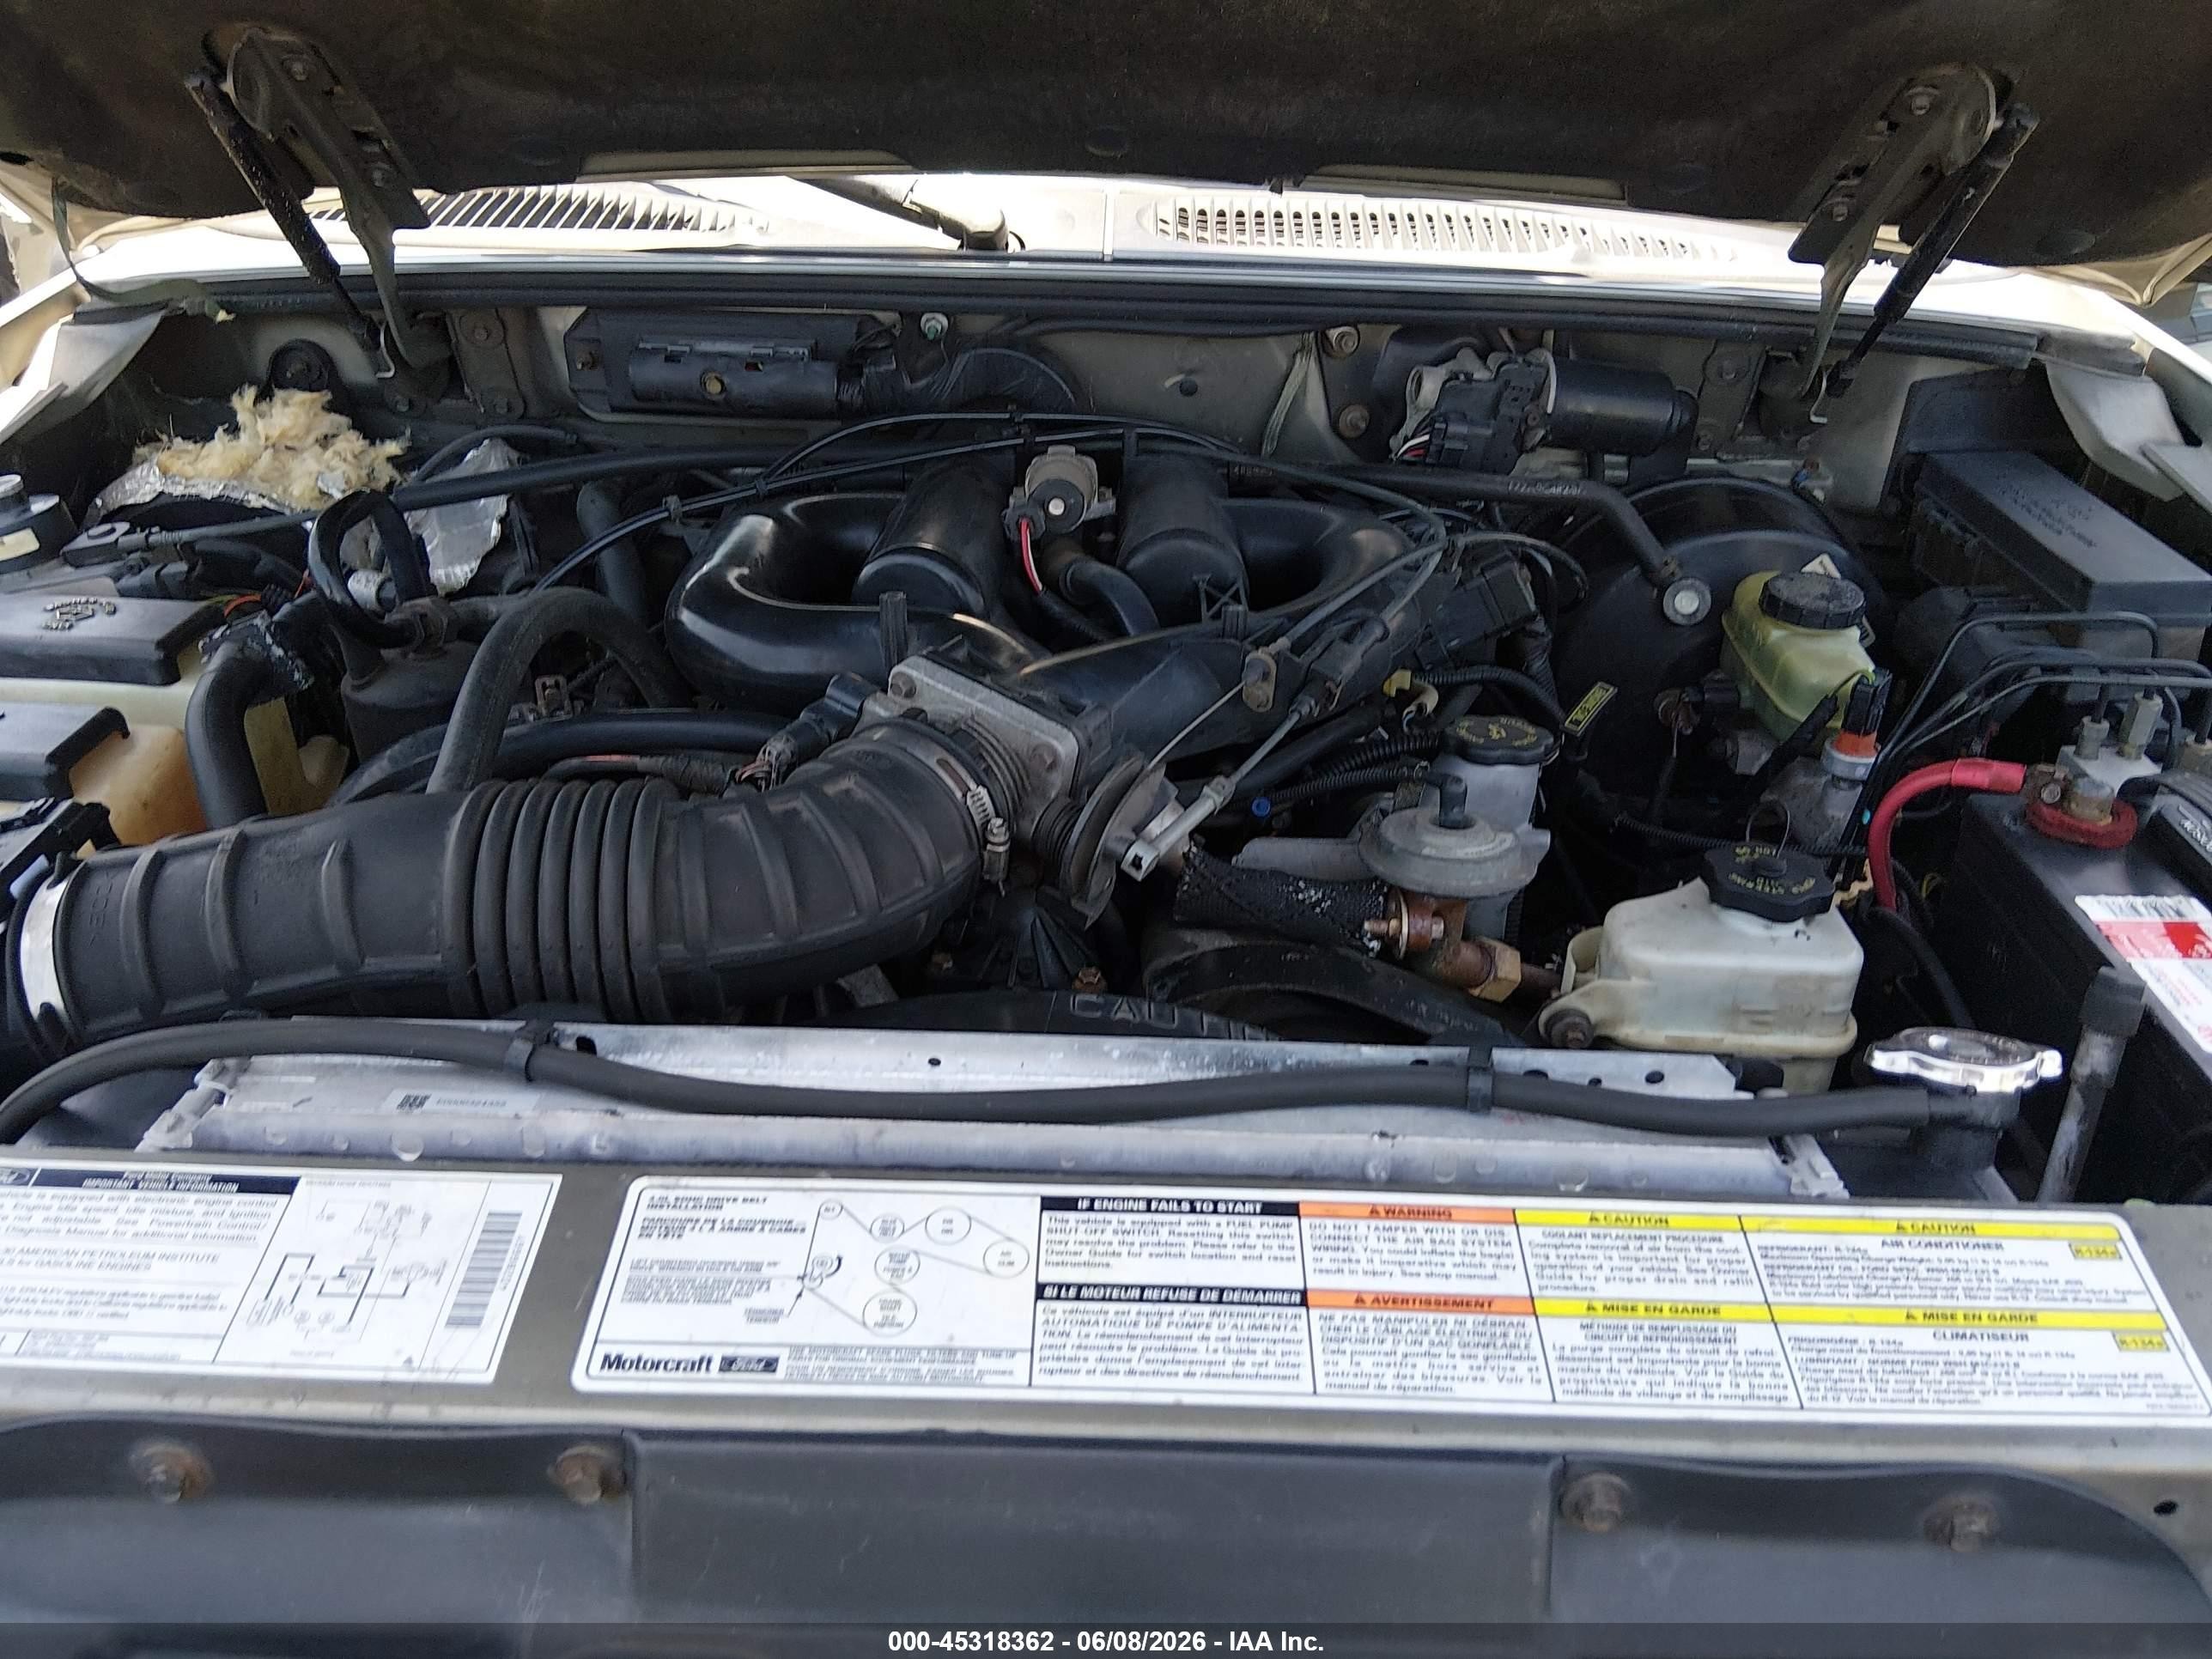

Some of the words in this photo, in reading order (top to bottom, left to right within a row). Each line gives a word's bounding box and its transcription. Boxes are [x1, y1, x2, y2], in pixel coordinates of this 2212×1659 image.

[1078, 1198, 1091, 1209] IF
[1093, 1198, 1147, 1211] ENGINE
[1151, 1200, 1191, 1212] FAILS
[1194, 1200, 1214, 1212] TO
[1217, 1201, 1261, 1213] START
[1384, 1208, 1453, 1217] WARNING
[1603, 1215, 1669, 1224] CAUTION
[1910, 1223, 1977, 1233] CAUTION
[1371, 1296, 1493, 1309] AVERTISSEMENT
[1602, 1304, 1638, 1313] MISE
[1644, 1304, 1664, 1313] EN
[1668, 1305, 1721, 1315] GARDE
[1922, 1312, 1958, 1321] MISE
[1962, 1312, 1982, 1322] EN
[1987, 1313, 2038, 1322] GARDE
[601, 1353, 713, 1371] Motorcraft
